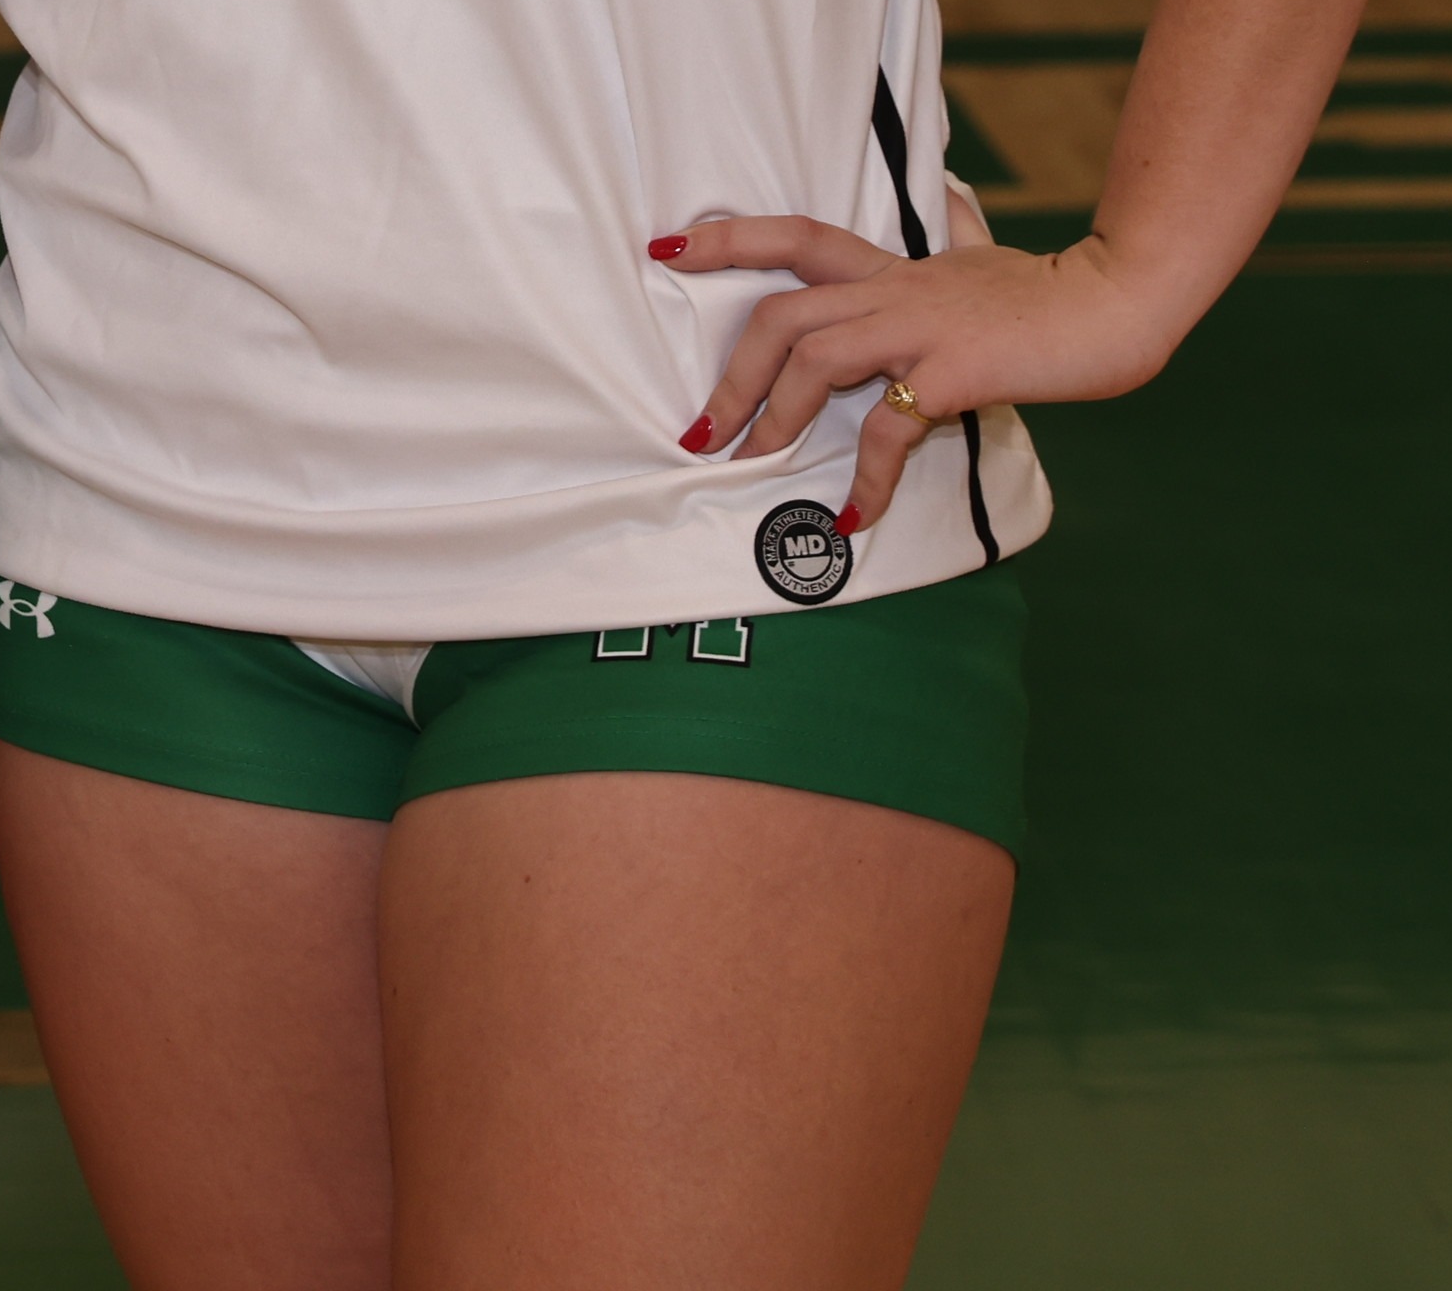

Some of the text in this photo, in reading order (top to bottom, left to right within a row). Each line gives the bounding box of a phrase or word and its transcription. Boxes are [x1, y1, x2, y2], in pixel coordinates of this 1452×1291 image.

[766, 531, 779, 561] MAKE
[775, 510, 820, 533] ATHLETES
[785, 535, 826, 557] MD
[775, 564, 841, 593] AUTHENTIC
